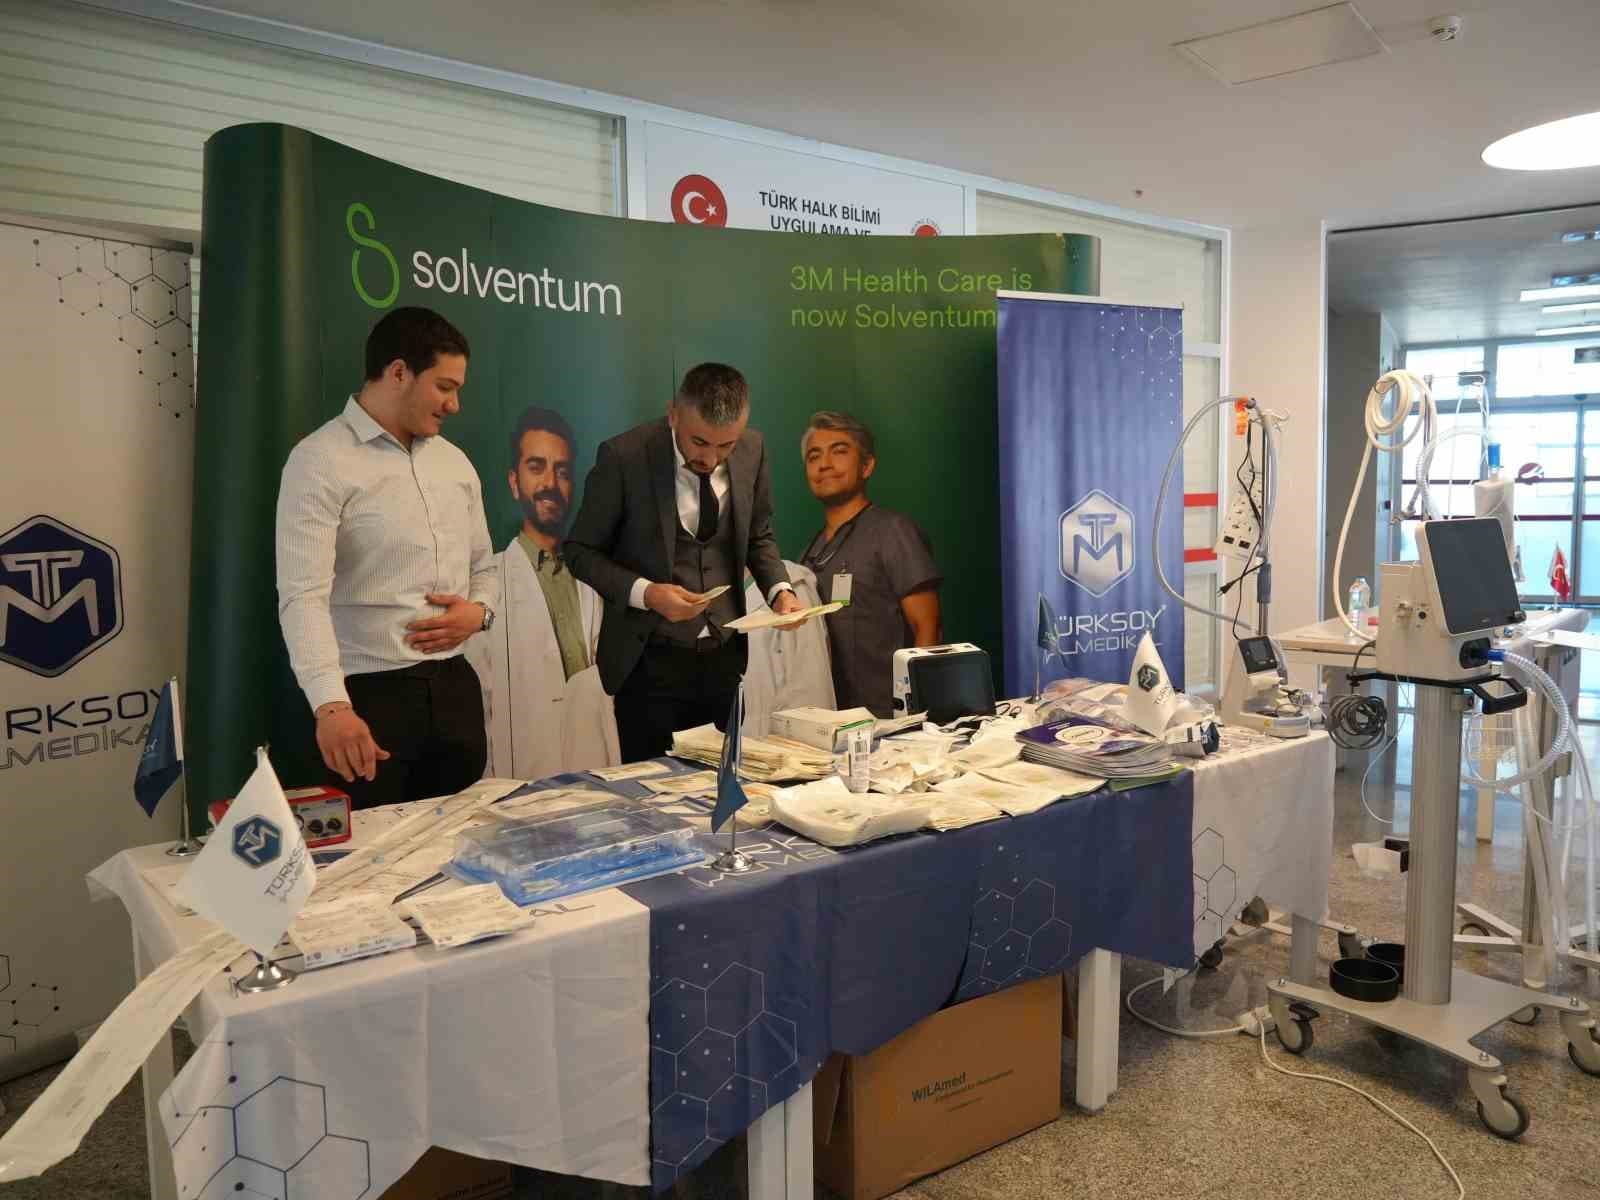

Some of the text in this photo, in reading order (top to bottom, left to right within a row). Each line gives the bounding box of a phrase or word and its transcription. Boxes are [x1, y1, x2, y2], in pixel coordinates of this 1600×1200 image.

[759, 190, 799, 212] TÜRK
[802, 200, 838, 218] HALK
[412, 247, 622, 315] solventum
[790, 265, 1033, 293] 3M Health Care is
[791, 303, 996, 328] now Solventum
[1054, 604, 1166, 637] ÜRKSOY
[1075, 631, 1163, 654] MEDİK
